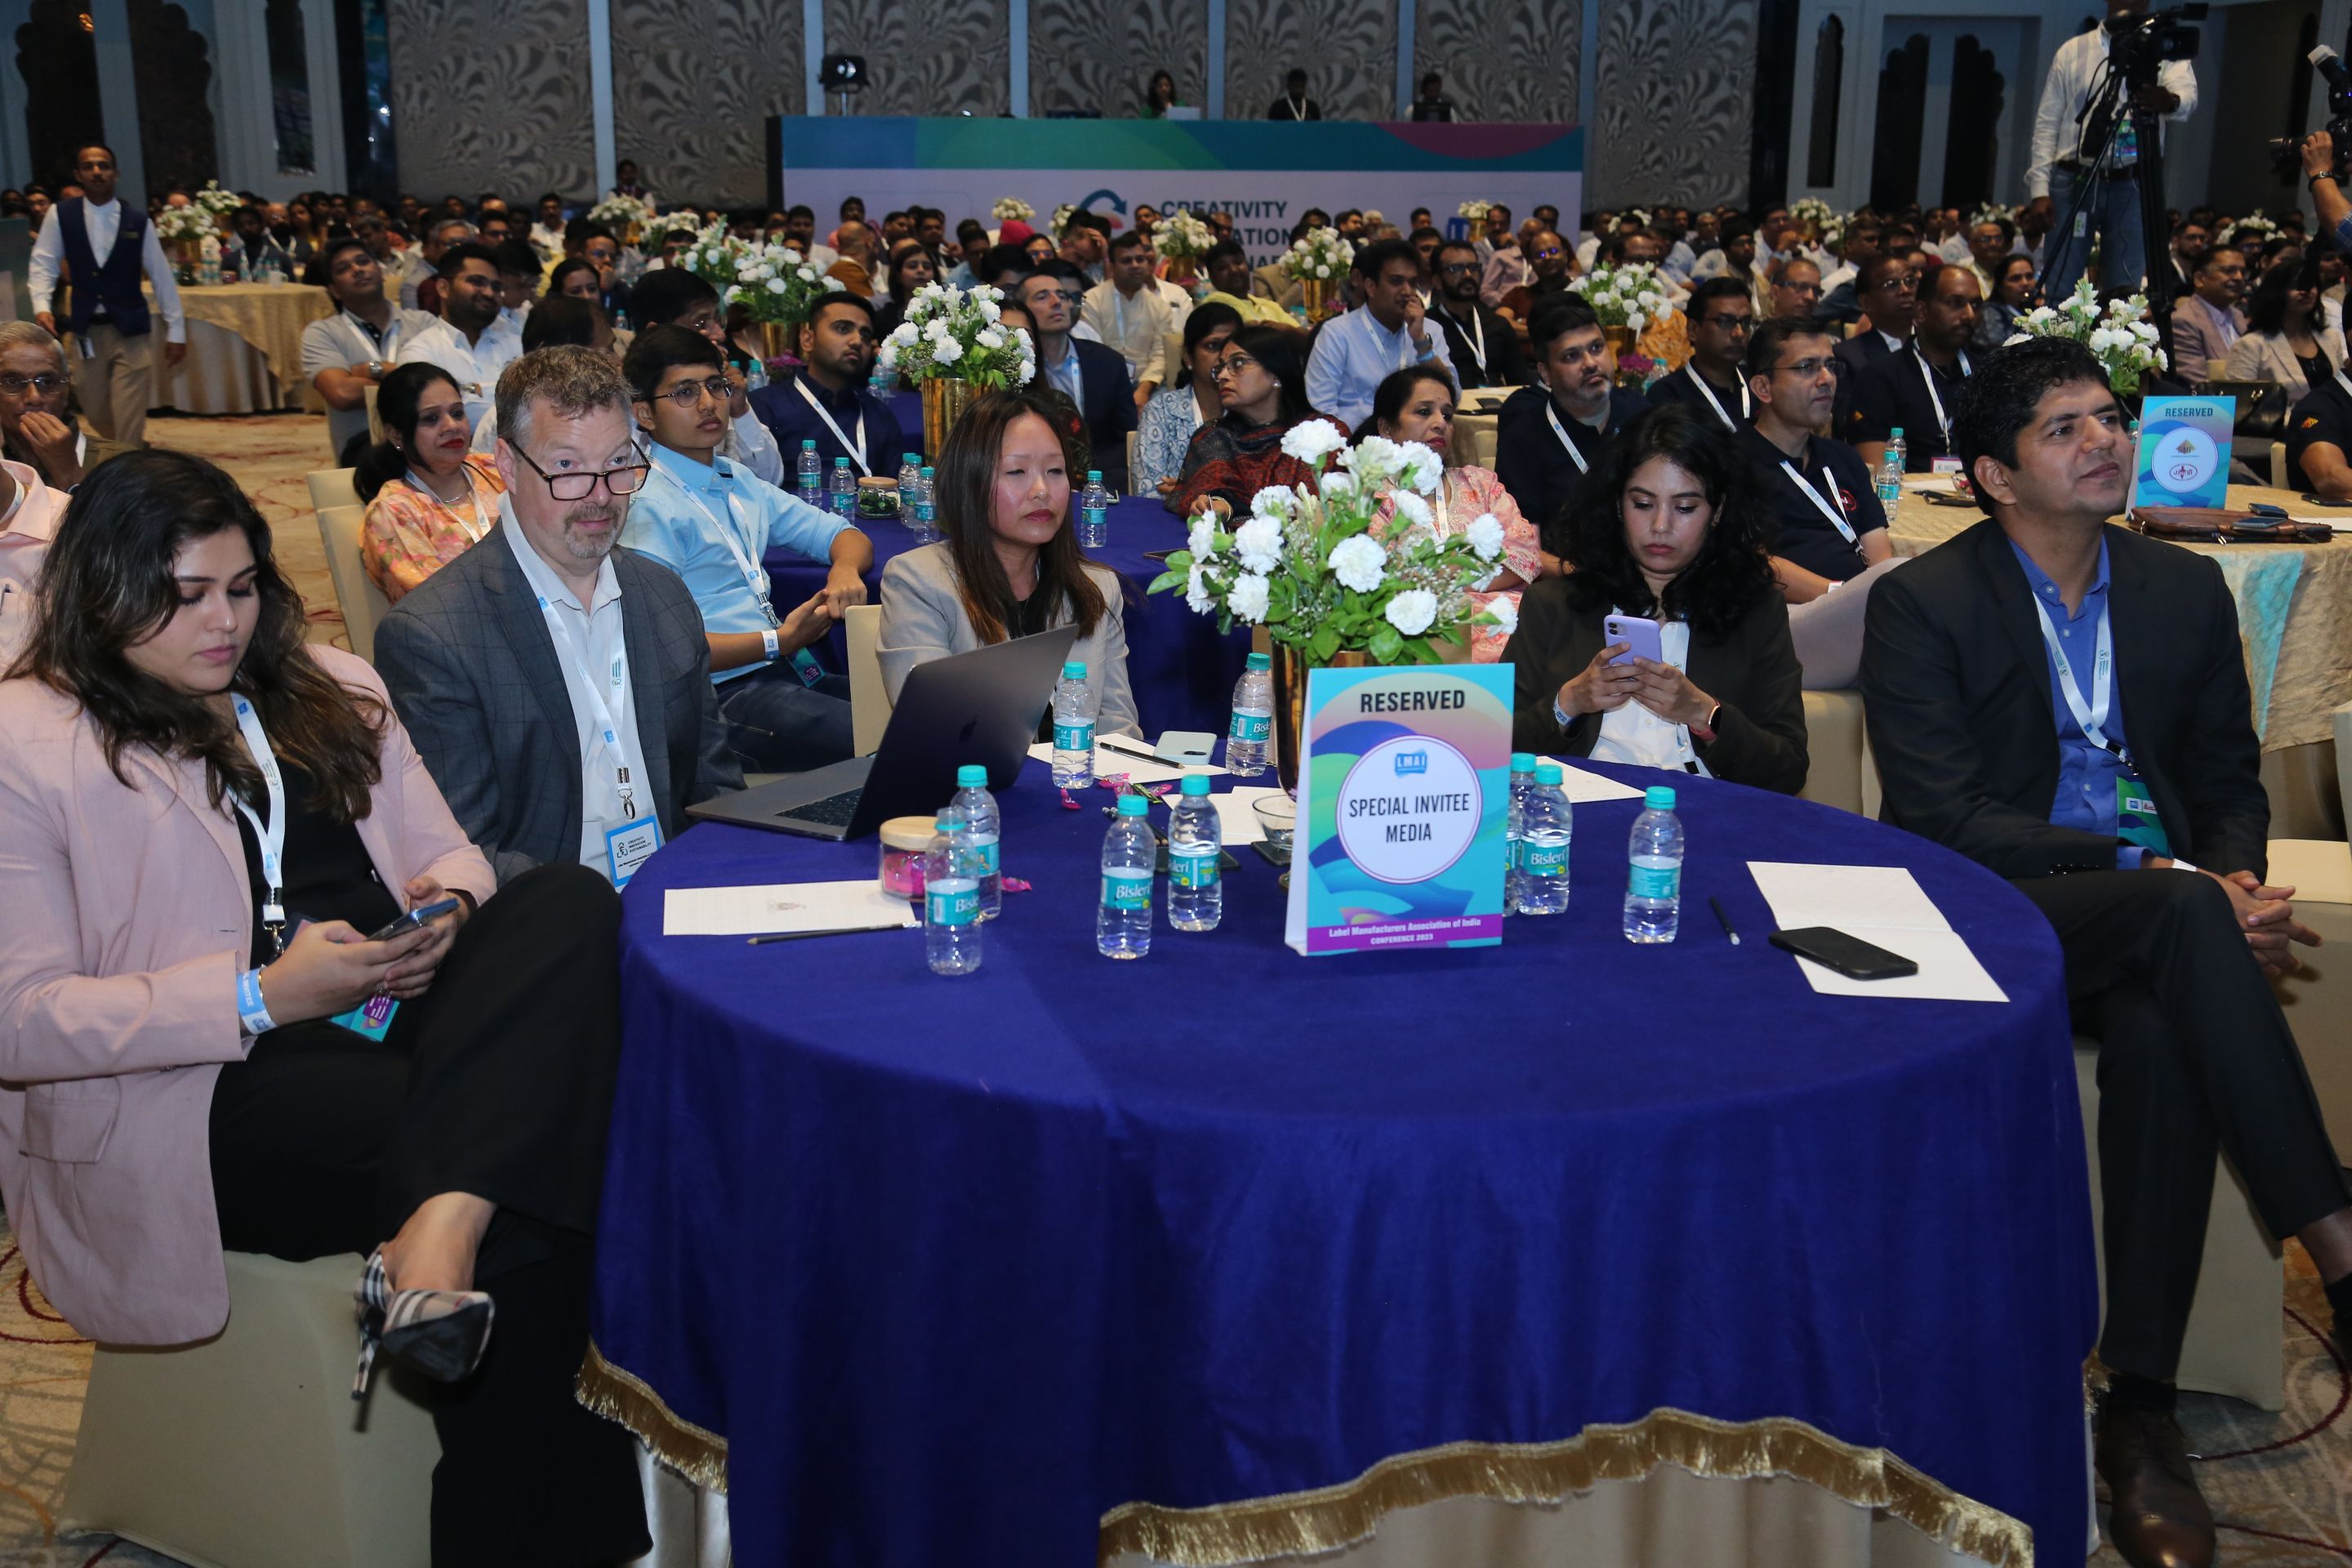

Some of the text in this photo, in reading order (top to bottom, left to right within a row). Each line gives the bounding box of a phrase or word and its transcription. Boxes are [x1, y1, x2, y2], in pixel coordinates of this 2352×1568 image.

[2165, 408, 2213, 417] RESERVED
[1361, 689, 1465, 713] RESERVED
[1397, 755, 1425, 768] LMAI
[1349, 793, 1470, 817] SPECIAL INVITEE
[1386, 822, 1432, 843] MEDIA
[1531, 849, 1566, 865] Bisleri
[1116, 883, 1151, 899] Bisleri
[1329, 918, 1481, 938] Label Manufacturers Association of India
[1370, 933, 1433, 945] CONFERENCE 2023
